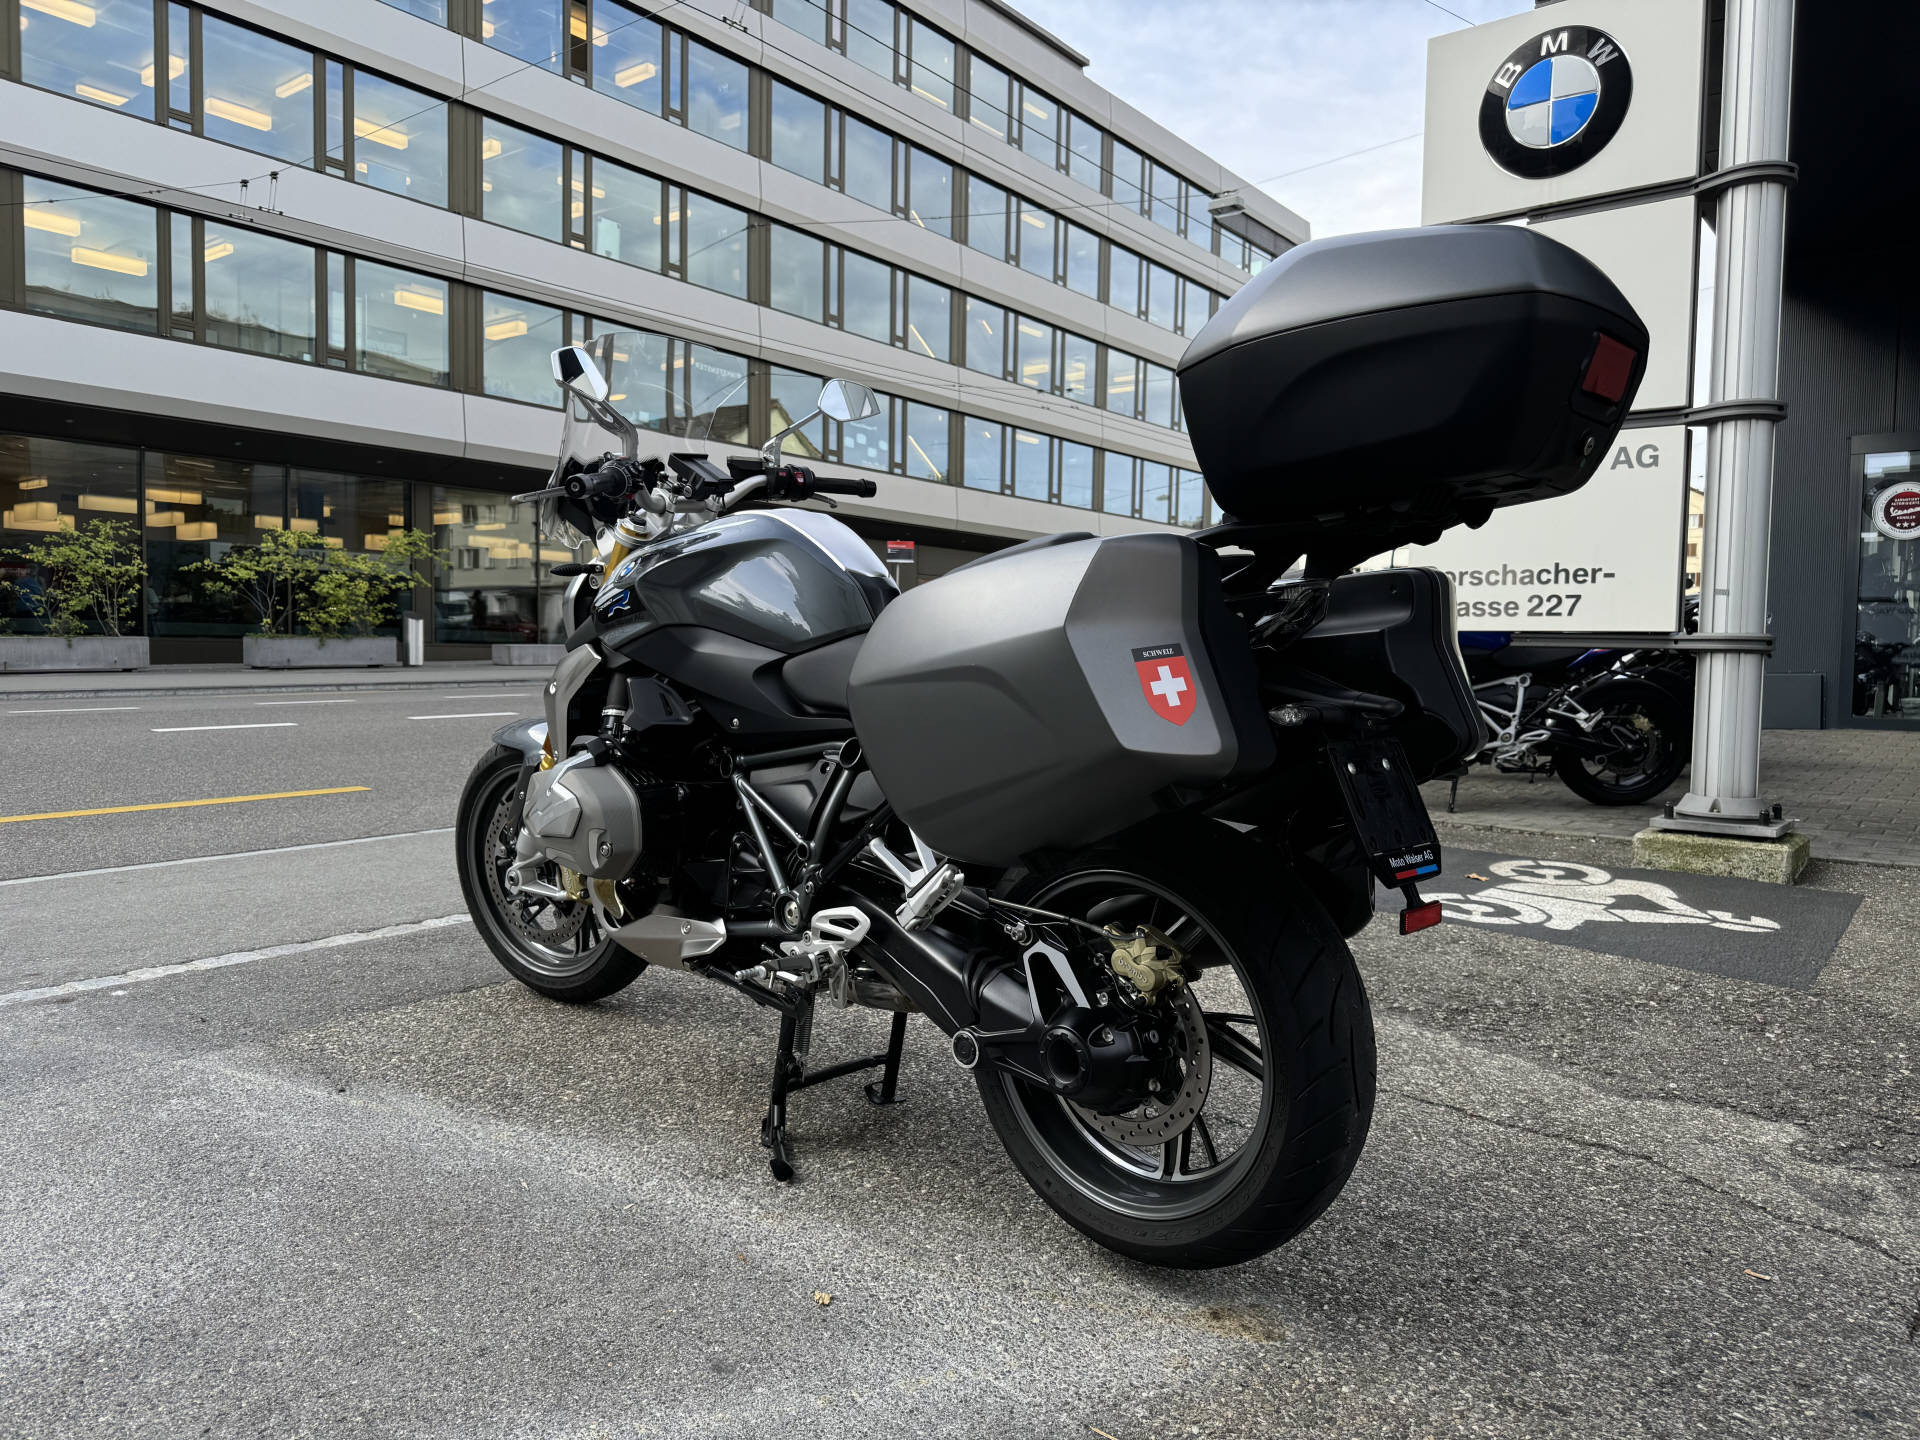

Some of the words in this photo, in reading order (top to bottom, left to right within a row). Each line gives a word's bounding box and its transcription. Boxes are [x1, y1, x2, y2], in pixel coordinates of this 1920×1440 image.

[1495, 30, 1618, 88] BMW
[1610, 444, 1659, 470] AG
[1445, 562, 1616, 586] rschacher-
[1456, 600, 1519, 617] asse
[1527, 594, 1582, 617] 227
[1142, 648, 1174, 657] SCHWEIZ
[1389, 857, 1405, 868] Moto
[1404, 853, 1423, 864] Walser
[1423, 850, 1434, 860] AG
